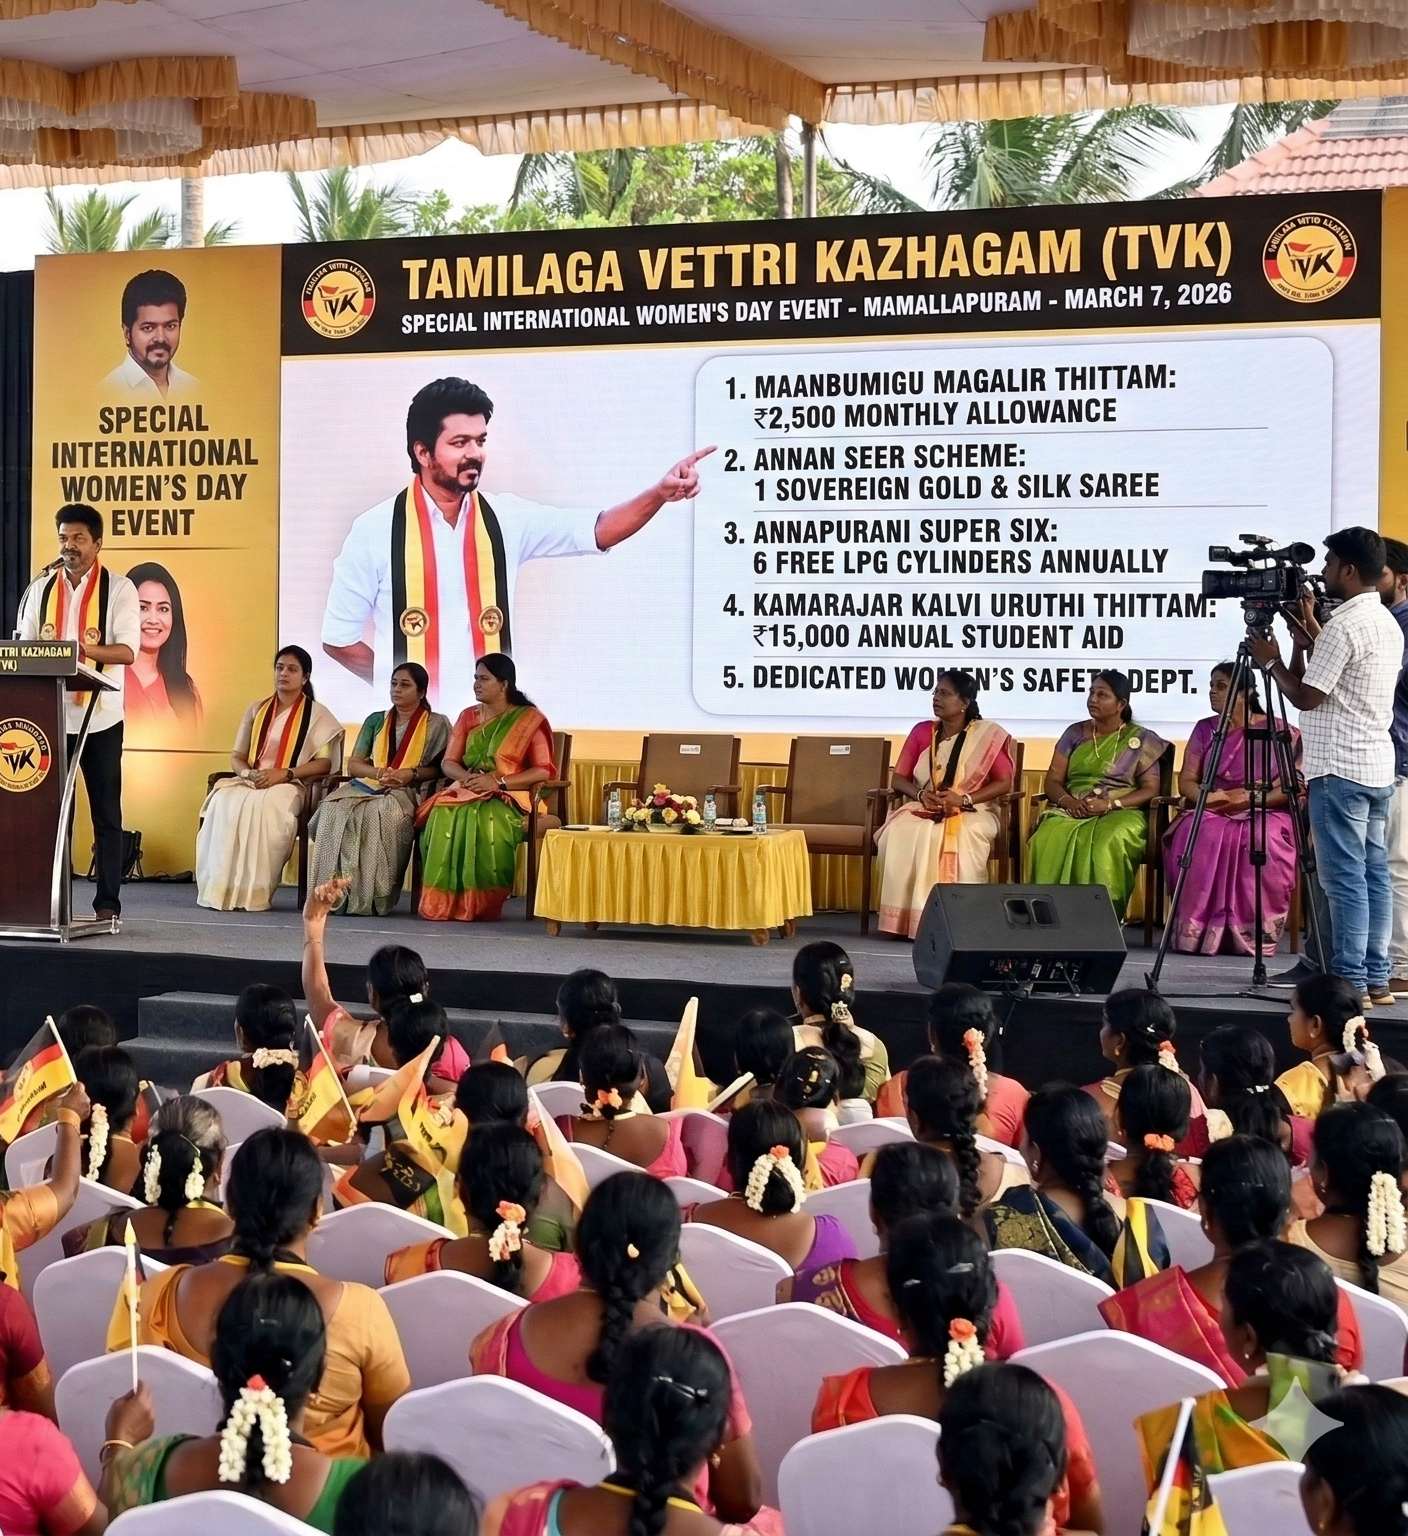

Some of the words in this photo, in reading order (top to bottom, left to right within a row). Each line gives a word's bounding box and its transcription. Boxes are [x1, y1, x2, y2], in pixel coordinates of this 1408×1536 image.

[402, 250, 624, 300] TAMILAGA
[638, 242, 797, 291] VETTRI
[816, 228, 1081, 283] KAZHAGAM
[1102, 221, 1232, 281] (TVK)
[401, 312, 478, 334] SPECIAL
[483, 306, 631, 331] INTERNATIONAL
[635, 301, 729, 326] WOMEN'S
[735, 300, 774, 322] DAY
[779, 297, 843, 321] EVENT
[863, 290, 1042, 317] MAMALLAPURAM
[1065, 285, 1143, 310] MARCH
[1150, 285, 1171, 310] 7,
[1177, 282, 1232, 306] 2026
[725, 376, 746, 400] 1.
[755, 370, 924, 399] MAANBUMIGU
[933, 367, 1047, 394] MAGALIR
[1054, 363, 1176, 392] THITTAM:
[98, 404, 209, 435] SPECIAL
[753, 404, 836, 434] ₹2,500
[844, 401, 959, 428] MONTHLY
[965, 397, 1117, 425] ALLOWANCE
[52, 438, 259, 469] INTERNATIONAL
[724, 448, 746, 472] 2.
[753, 446, 835, 471] ANNAN
[844, 445, 905, 470] SEER
[913, 443, 1026, 469] SCHEME:
[60, 473, 187, 503] WOMEN’S
[196, 473, 248, 501] DAY
[754, 478, 765, 502] 1
[776, 476, 910, 502] SOVEREIGN
[918, 475, 982, 500] GOLD
[990, 474, 1009, 499] &
[1017, 473, 1072, 499] SILK
[1079, 472, 1160, 499] SAREE
[111, 508, 196, 536] EVENT
[723, 521, 745, 545] 3.
[753, 519, 910, 544] ANNAPURANI
[919, 518, 1001, 544] SUPER
[1009, 517, 1058, 543] SIX:
[753, 551, 767, 575] 6
[776, 550, 835, 574] FREE
[843, 550, 888, 574] LPG
[897, 549, 1032, 574] CYLINDERS
[1039, 548, 1169, 574] ANNUALLY
[722, 593, 745, 617] 4.
[753, 593, 903, 618] KAMARAJAR
[912, 593, 981, 617] KALVI
[991, 593, 1085, 618] URUTHI
[1094, 593, 1216, 618] THITTAM:
[752, 623, 850, 652] ₹15,000
[857, 624, 954, 649] ANNUAL
[961, 623, 1074, 649] STUDENT
[1081, 625, 1124, 650] AID
[723, 665, 744, 689] 5.
[753, 665, 886, 690] DEDICATED
[894, 667, 1014, 691] WON’S
[1128, 668, 1198, 694] DEPT.
